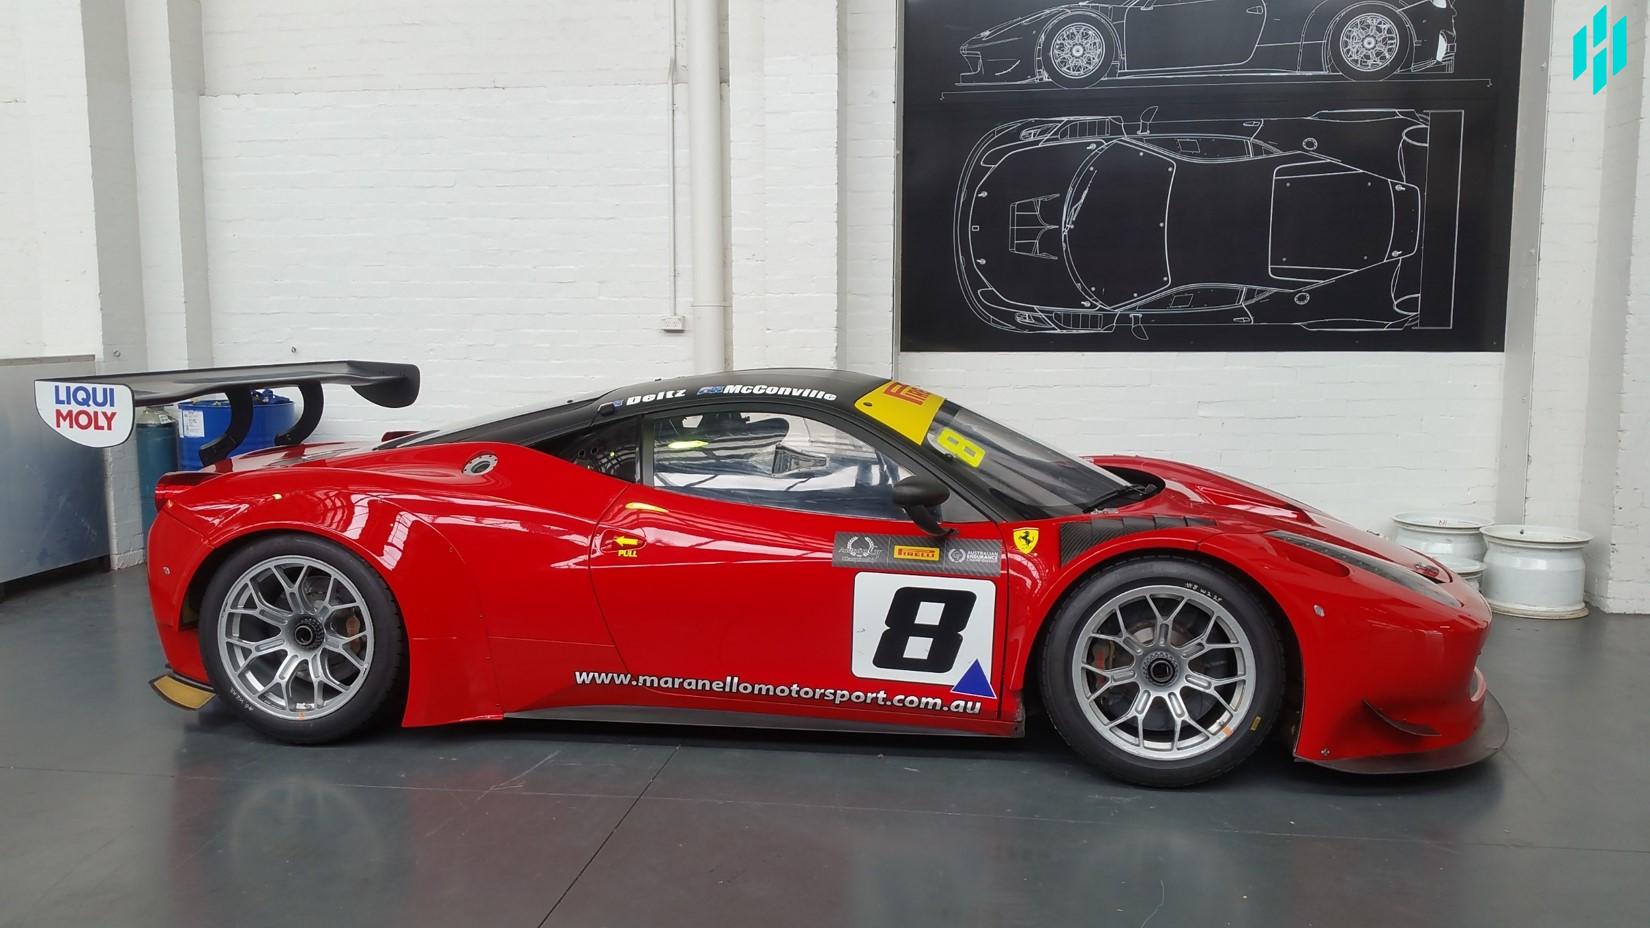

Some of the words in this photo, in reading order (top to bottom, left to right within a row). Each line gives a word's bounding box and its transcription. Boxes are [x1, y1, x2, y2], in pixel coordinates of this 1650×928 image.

[54, 385, 116, 407] LIQUI
[723, 384, 838, 401] McConville
[55, 409, 117, 431] MOLY
[936, 426, 986, 468] 8
[617, 549, 638, 558] PULL
[897, 548, 936, 558] PIRELLI
[872, 586, 977, 674] 8
[574, 671, 982, 715] www.maranellomotorsport.com.au
